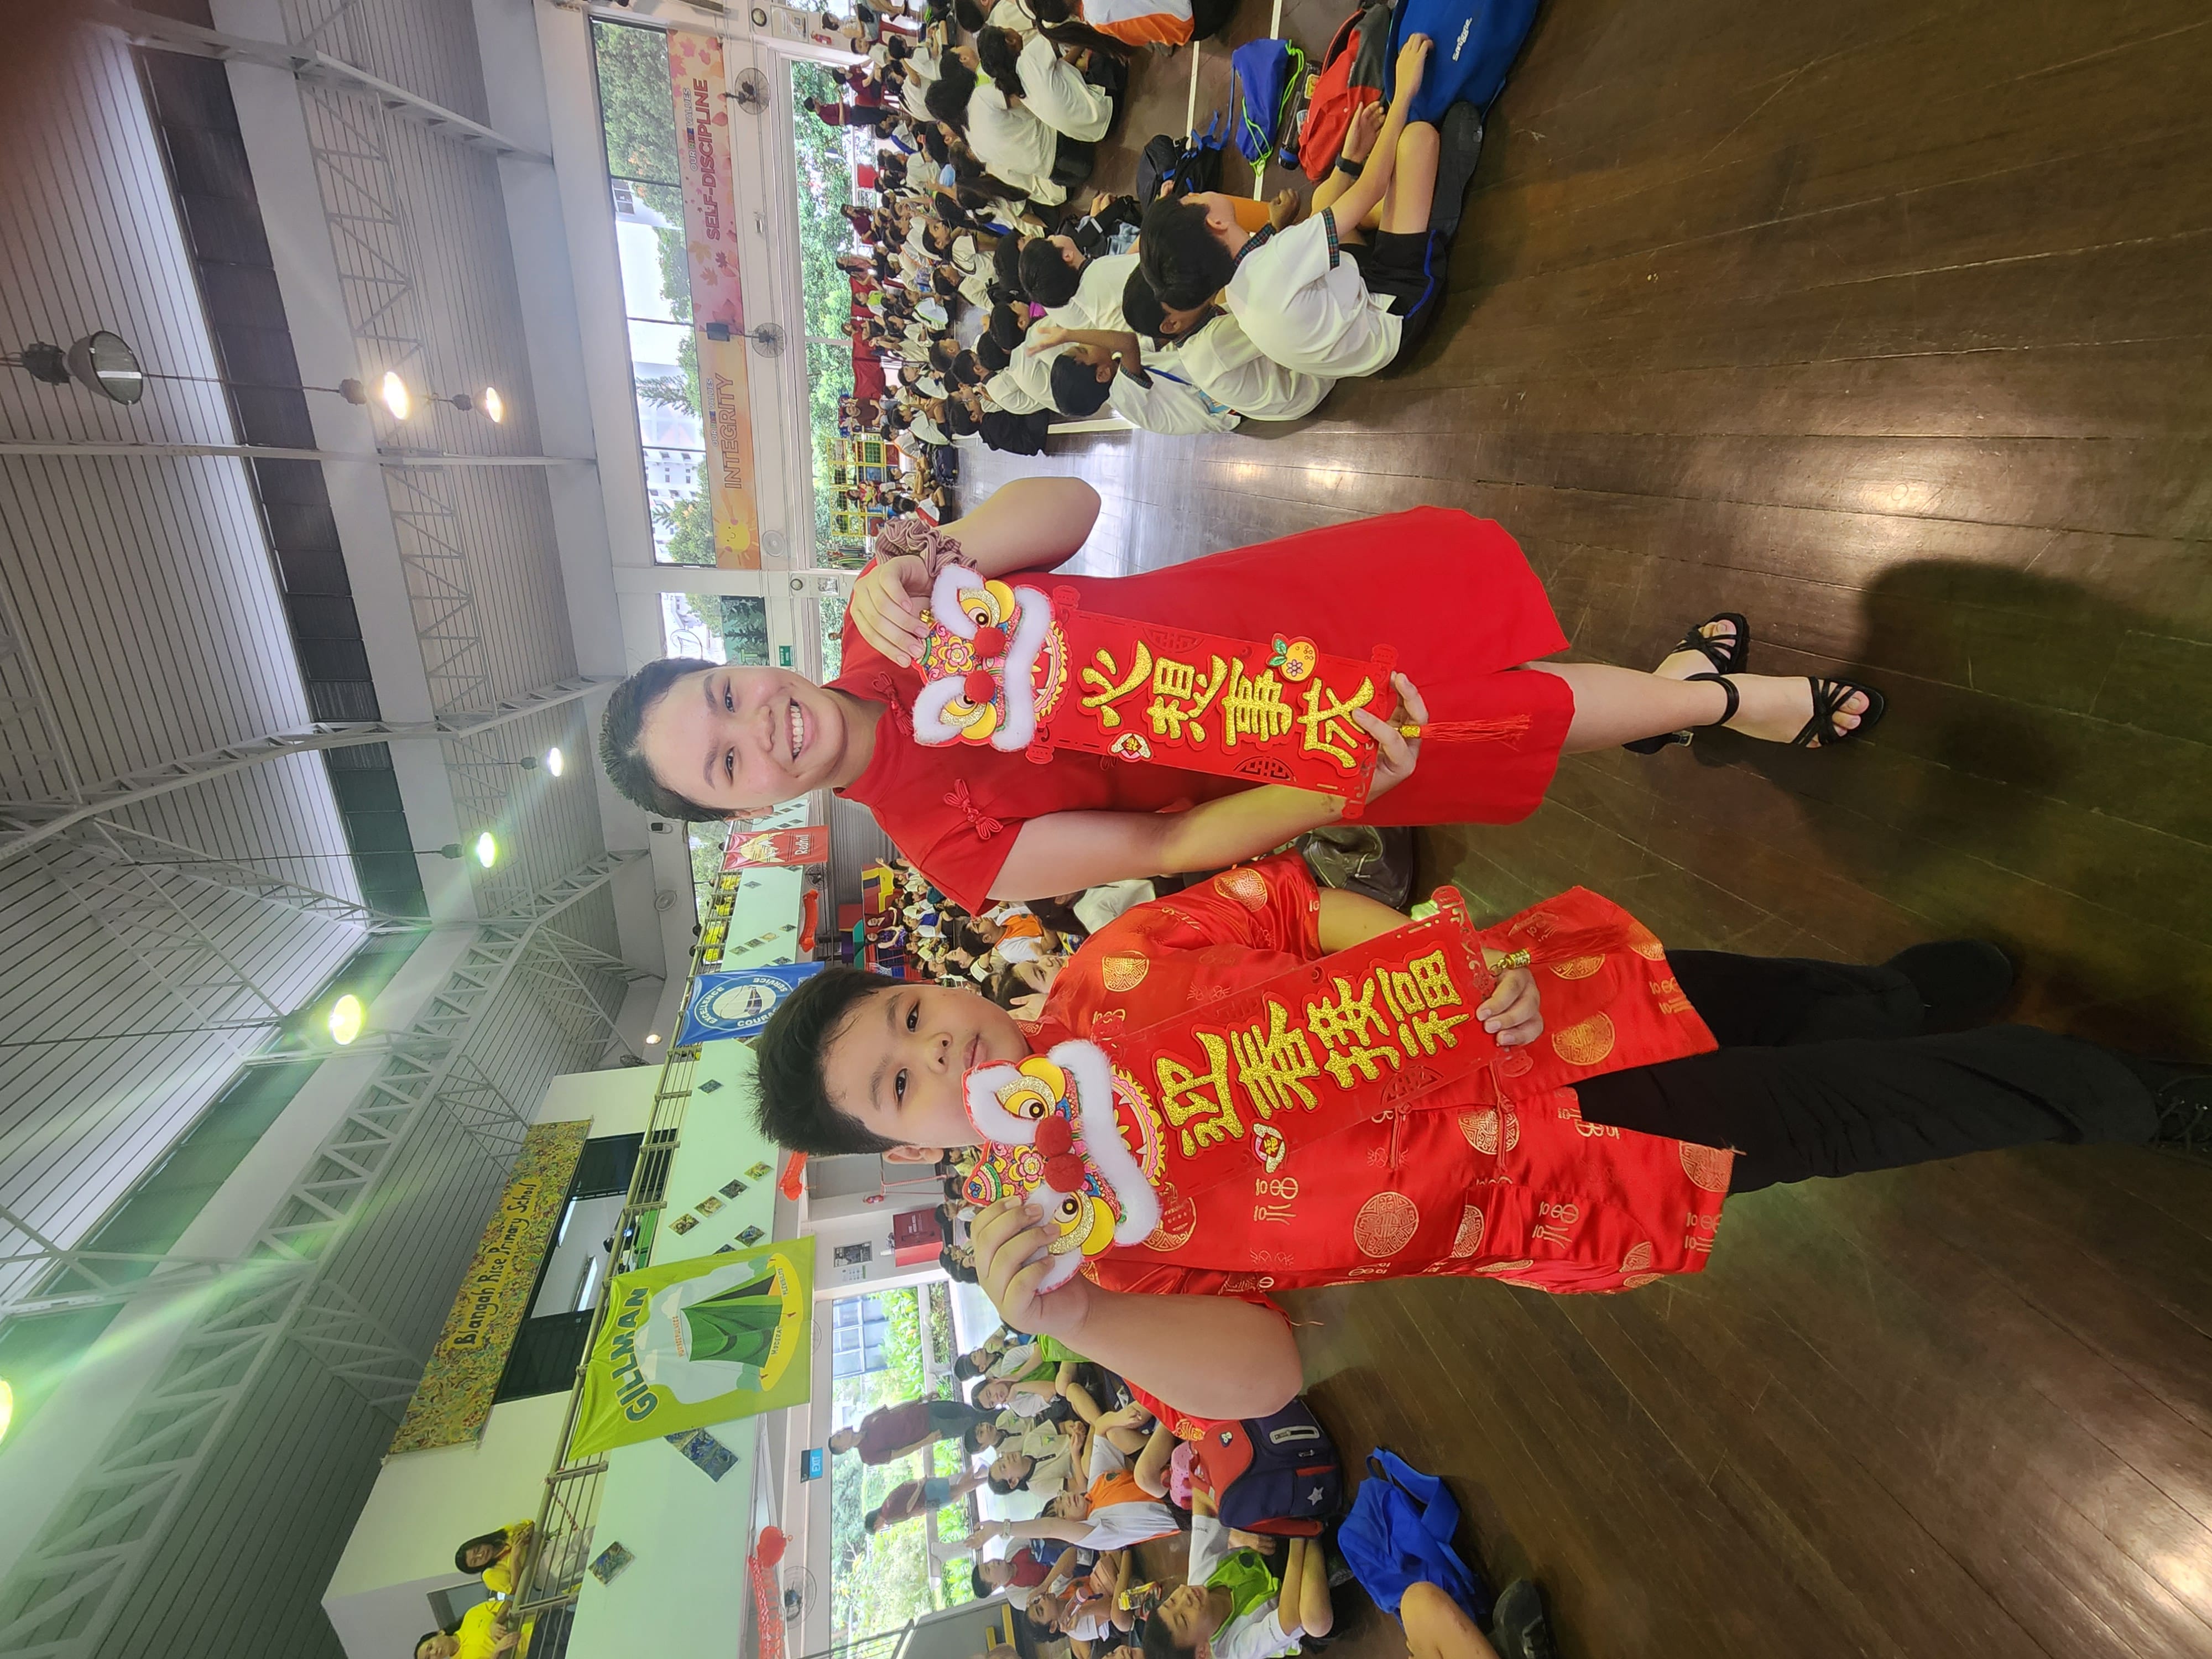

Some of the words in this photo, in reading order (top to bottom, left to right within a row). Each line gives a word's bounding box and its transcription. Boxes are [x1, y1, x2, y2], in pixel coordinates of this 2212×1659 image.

[683, 87, 694, 127] VALUES
[689, 150, 698, 171] OUR
[692, 77, 721, 241] SELF-DISCIPLINE
[706, 377, 715, 411] VALUES
[711, 429, 719, 447] OUR
[714, 372, 742, 489] INTEGRITY
[1079, 639, 1376, 770] 心想事成
[794, 833, 809, 855] Redhill
[752, 977, 788, 992] SERVICE
[698, 986, 725, 1024] EXCELLENCE
[1155, 948, 1470, 1161] 迎春接福
[1263, 1136, 1279, 1155] 福
[507, 1182, 537, 1213] School
[486, 1218, 530, 1255] Primary
[476, 1258, 507, 1282] Rise
[778, 1268, 789, 1295] FLEXIBILITY
[453, 1287, 499, 1345] Blangah
[609, 1287, 658, 1422] GILLMAN
[770, 1326, 783, 1355] MODERAT
[811, 1455, 821, 1473] EXIT
